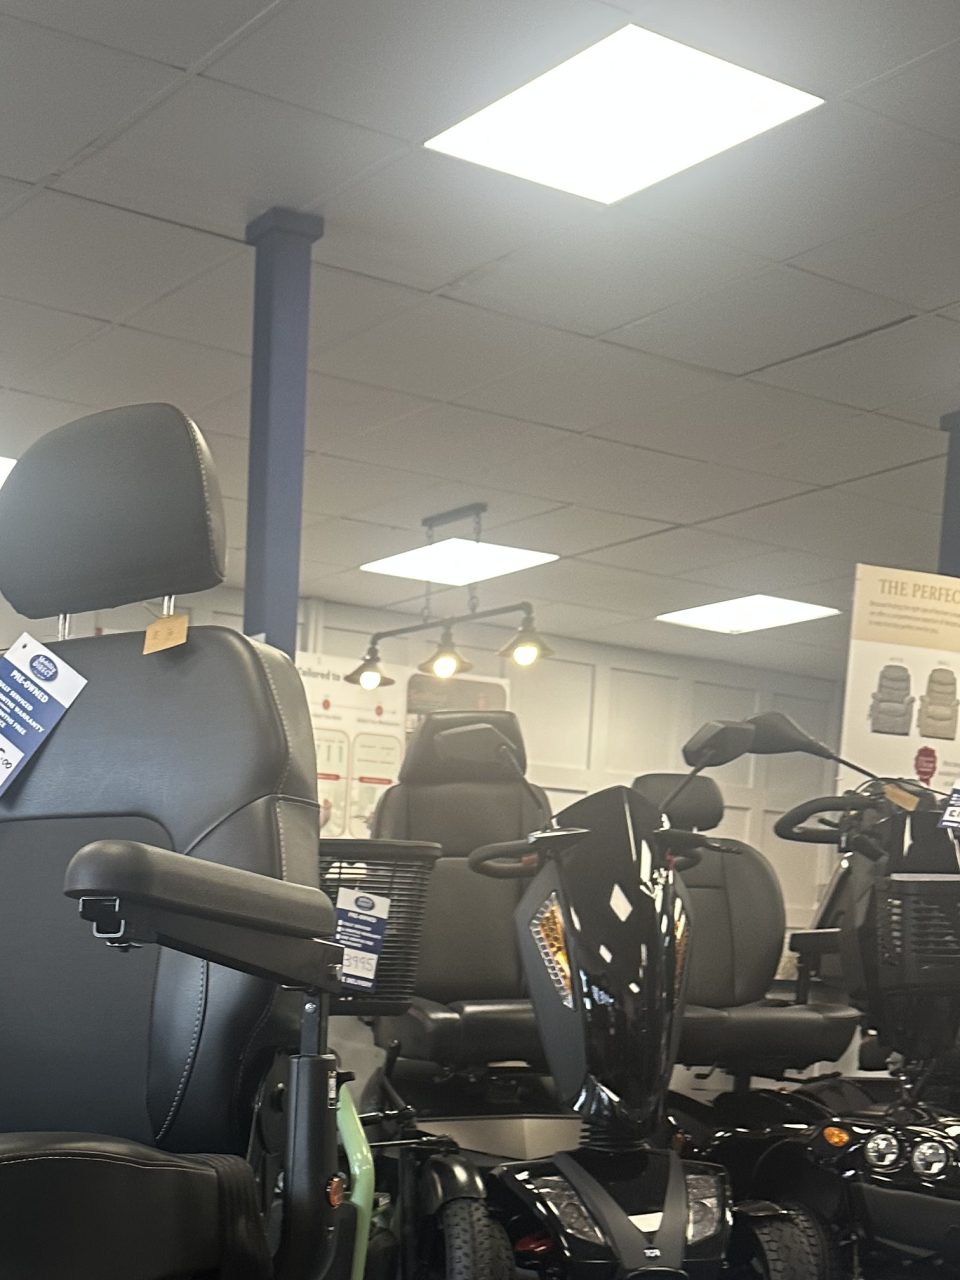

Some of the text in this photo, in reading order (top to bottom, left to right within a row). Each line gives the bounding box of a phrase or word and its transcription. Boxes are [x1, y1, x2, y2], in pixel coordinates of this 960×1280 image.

[878, 578, 908, 597] THE
[10, 669, 49, 703] PRE-OWNED
[9, 688, 34, 711] SERVICED
[12, 719, 27, 735] FREE
[13, 705, 46, 733] WARRANTY
